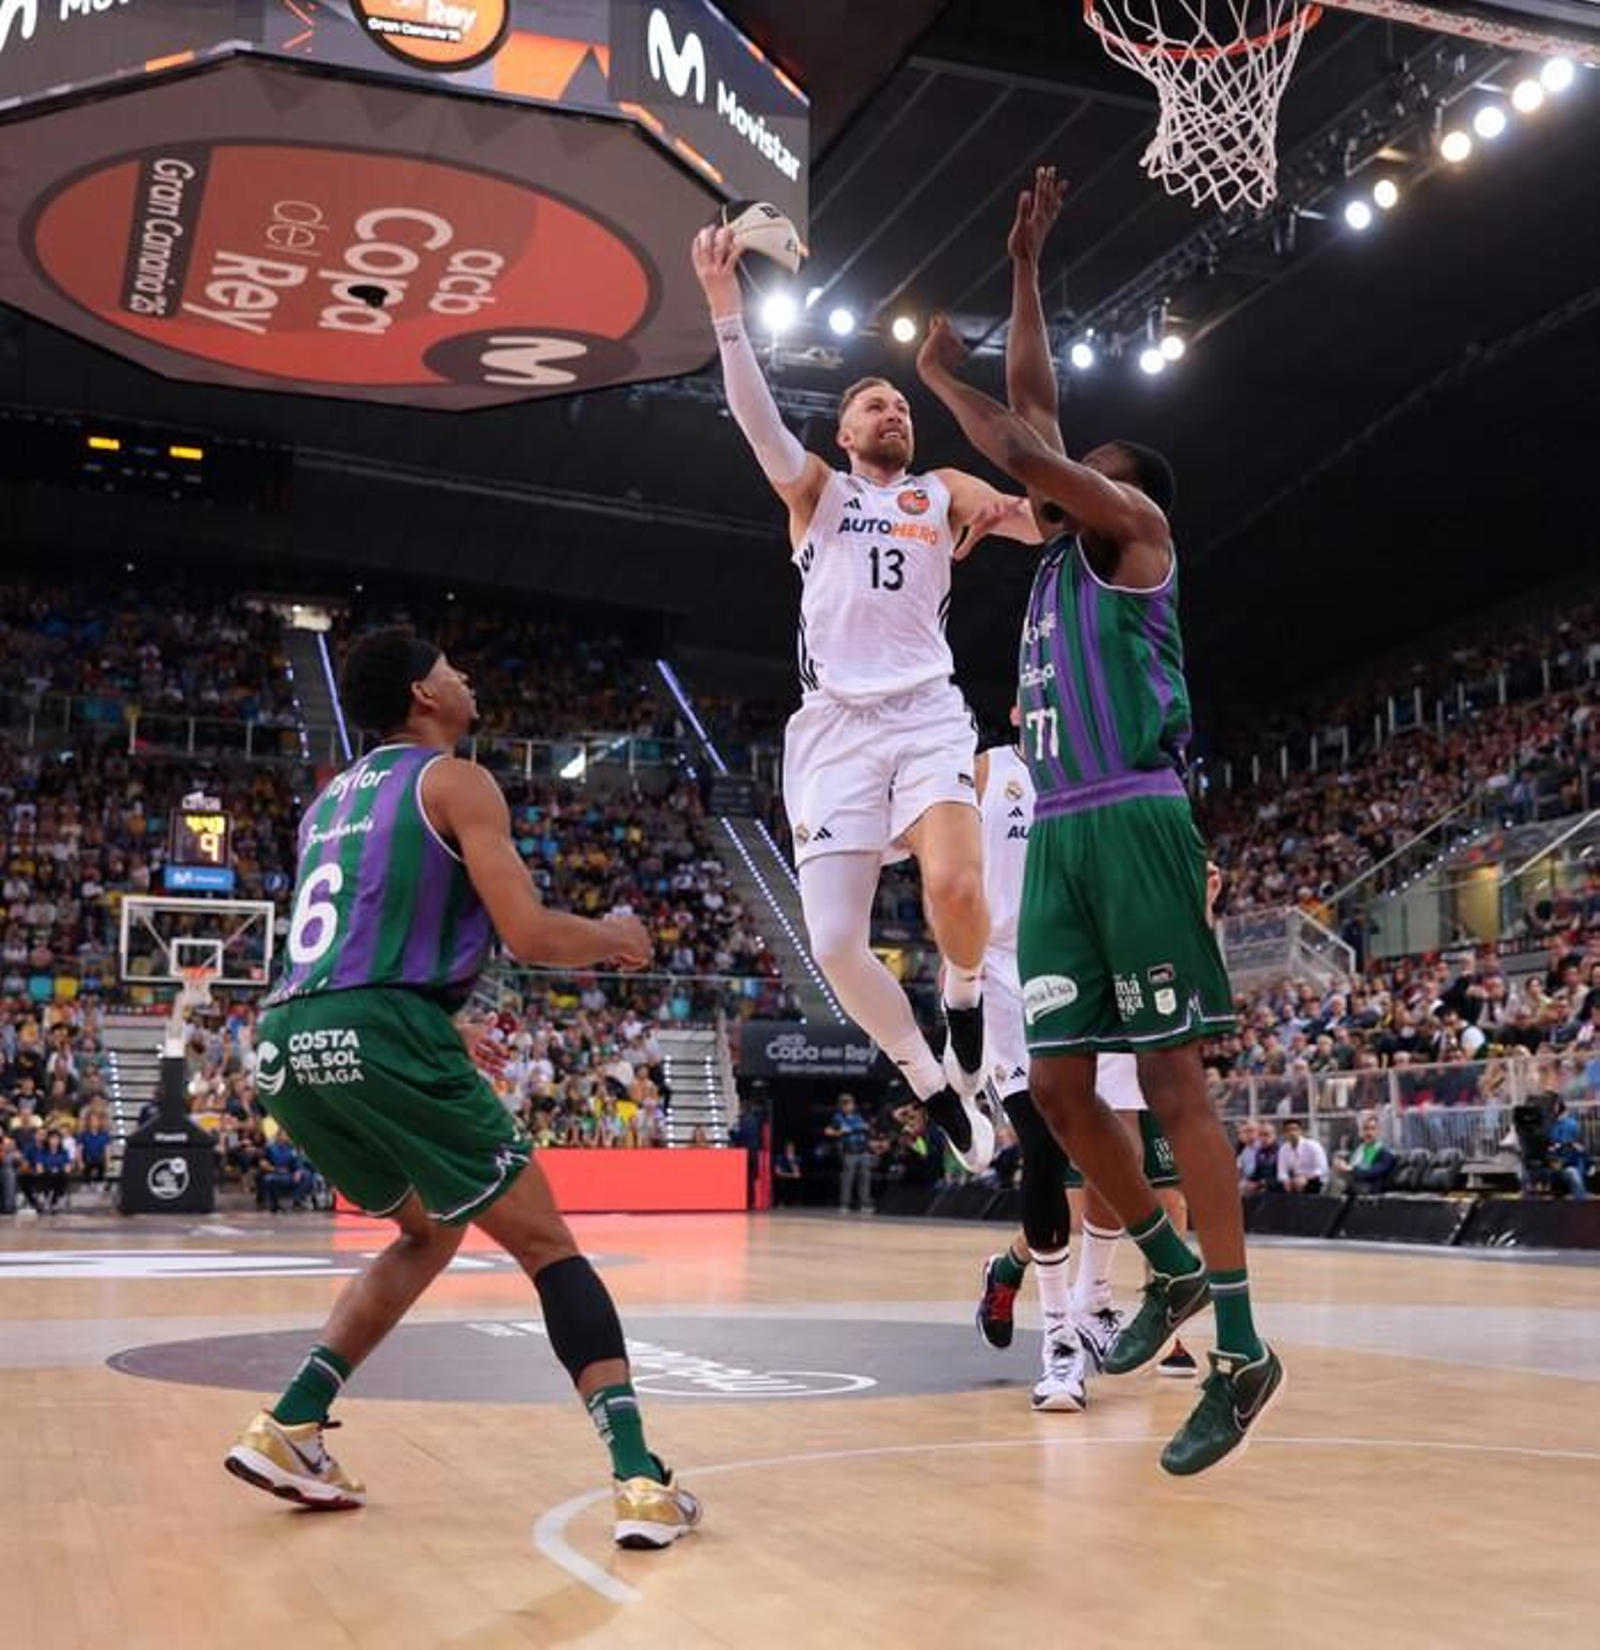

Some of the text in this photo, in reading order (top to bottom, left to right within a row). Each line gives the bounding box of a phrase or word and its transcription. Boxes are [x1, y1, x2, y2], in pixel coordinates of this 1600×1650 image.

[717, 79, 800, 182] Movistar
[147, 158, 196, 217] Gran
[133, 217, 184, 294] Canaria
[264, 200, 330, 257] del
[182, 250, 309, 335] Rey
[318, 207, 453, 335] Copa
[428, 249, 505, 315] acb
[838, 516, 938, 546] AUTOHERO
[869, 546, 906, 592] 13
[200, 832, 219, 862] 9
[288, 862, 344, 965] 6
[288, 1028, 360, 1053] COSTA
[289, 1049, 362, 1070] DEL SOL
[765, 1041, 820, 1063] Copa
[844, 1043, 879, 1064] Rey
